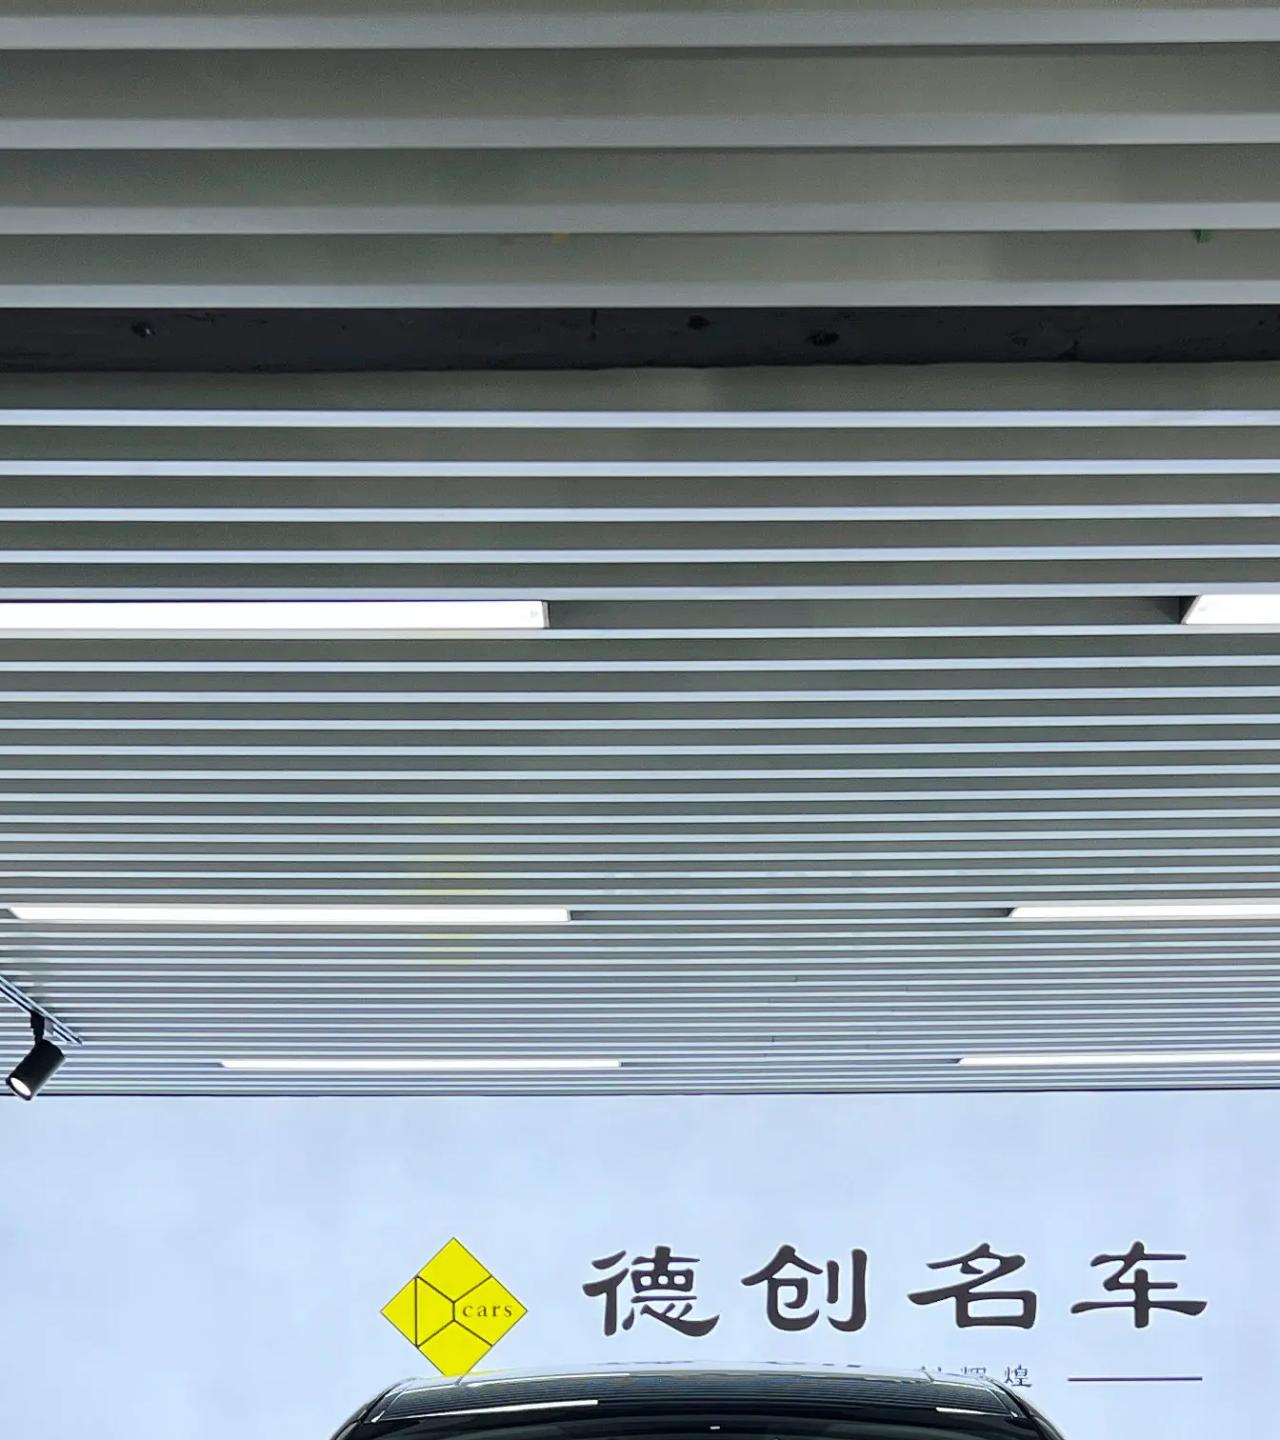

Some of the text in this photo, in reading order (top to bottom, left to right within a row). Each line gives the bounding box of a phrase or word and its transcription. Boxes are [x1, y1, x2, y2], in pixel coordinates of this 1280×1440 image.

[462, 1304, 513, 1318] cars
[582, 1241, 1209, 1338] 德创名车
